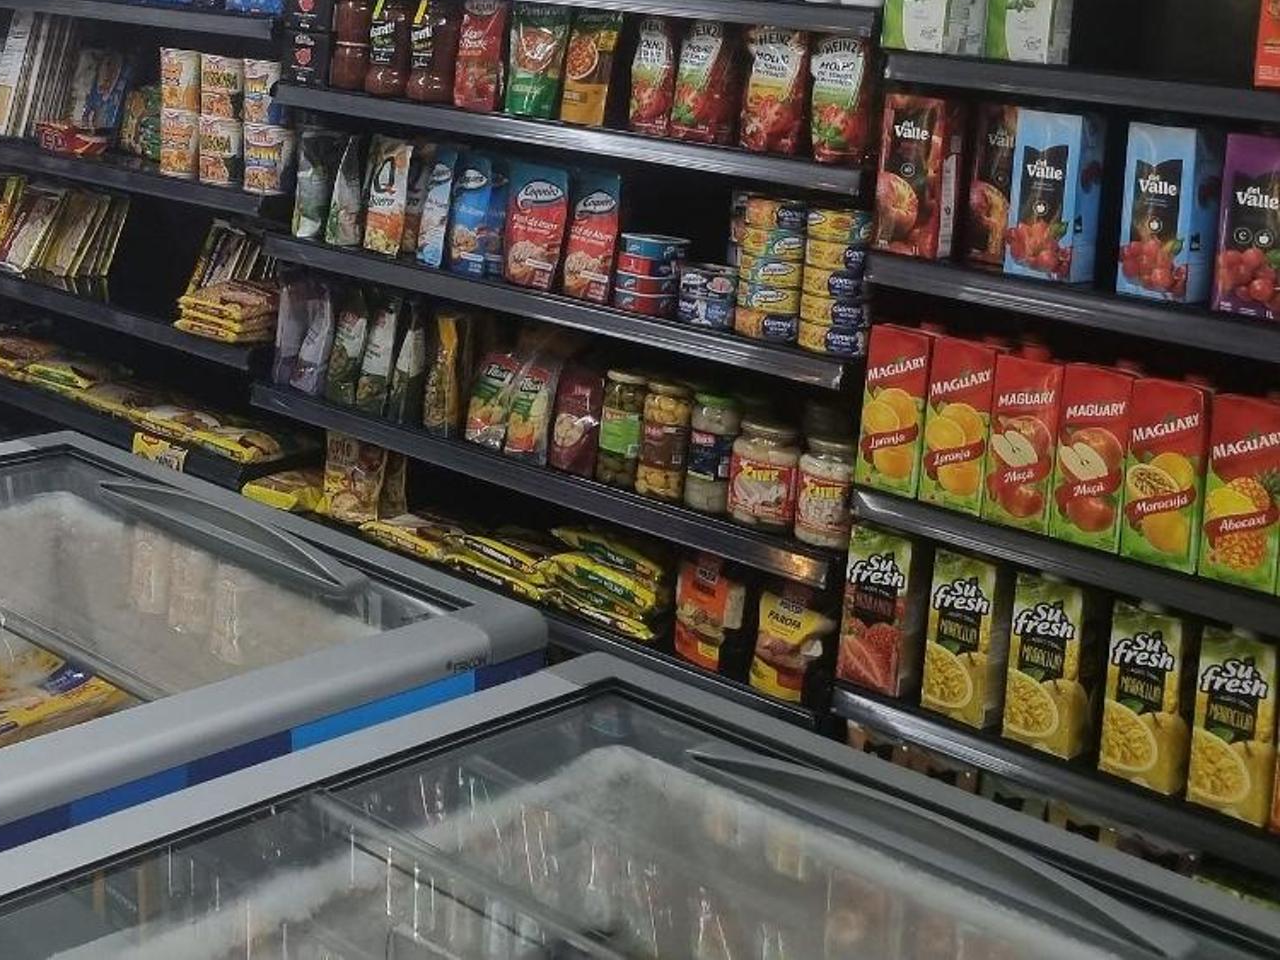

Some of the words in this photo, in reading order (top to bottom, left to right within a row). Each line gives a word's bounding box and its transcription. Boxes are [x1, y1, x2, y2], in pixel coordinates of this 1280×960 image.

[822, 40, 858, 54] HEINZ
[894, 124, 930, 141] Valle
[1026, 163, 1063, 181] Valle
[1138, 178, 1178, 197] Valle
[1235, 190, 1280, 211] Valle
[867, 356, 927, 382] MAGUARY
[931, 368, 993, 397] MAGUARY
[997, 389, 1056, 408] MAGUARY
[1065, 400, 1127, 420] MAGUARY
[1131, 412, 1200, 443] MAGUARY
[1212, 429, 1280, 462] MAGUAR
[850, 560, 904, 588] fresh
[934, 585, 990, 615] fresh
[1014, 610, 1075, 639] fresh
[1113, 640, 1174, 671] fresh
[1201, 666, 1268, 698] fresh
